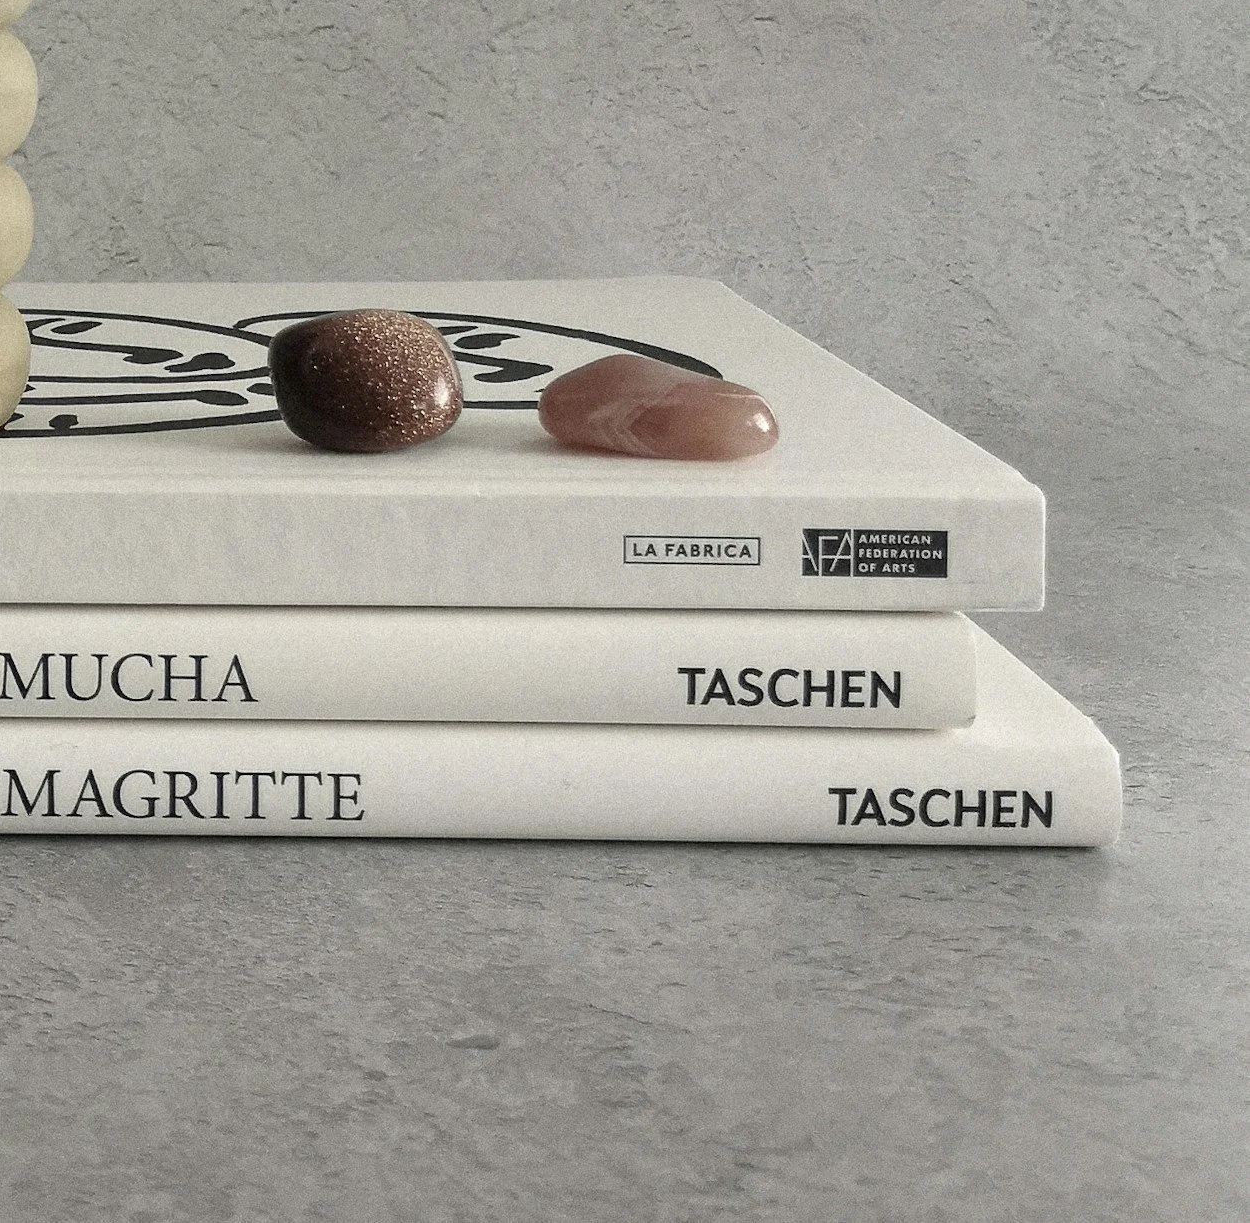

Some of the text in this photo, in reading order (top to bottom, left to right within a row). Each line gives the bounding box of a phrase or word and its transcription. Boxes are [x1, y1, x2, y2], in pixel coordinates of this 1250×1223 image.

[858, 534, 931, 545] AMERICAN
[633, 543, 752, 558] LA FABRICA
[858, 548, 943, 560] FEDERATION
[858, 562, 916, 573] OF ARTS
[677, 667, 902, 709] TASCHEN
[0, 769, 365, 821] MAGRITTE
[828, 787, 1053, 829] TASCHEN
